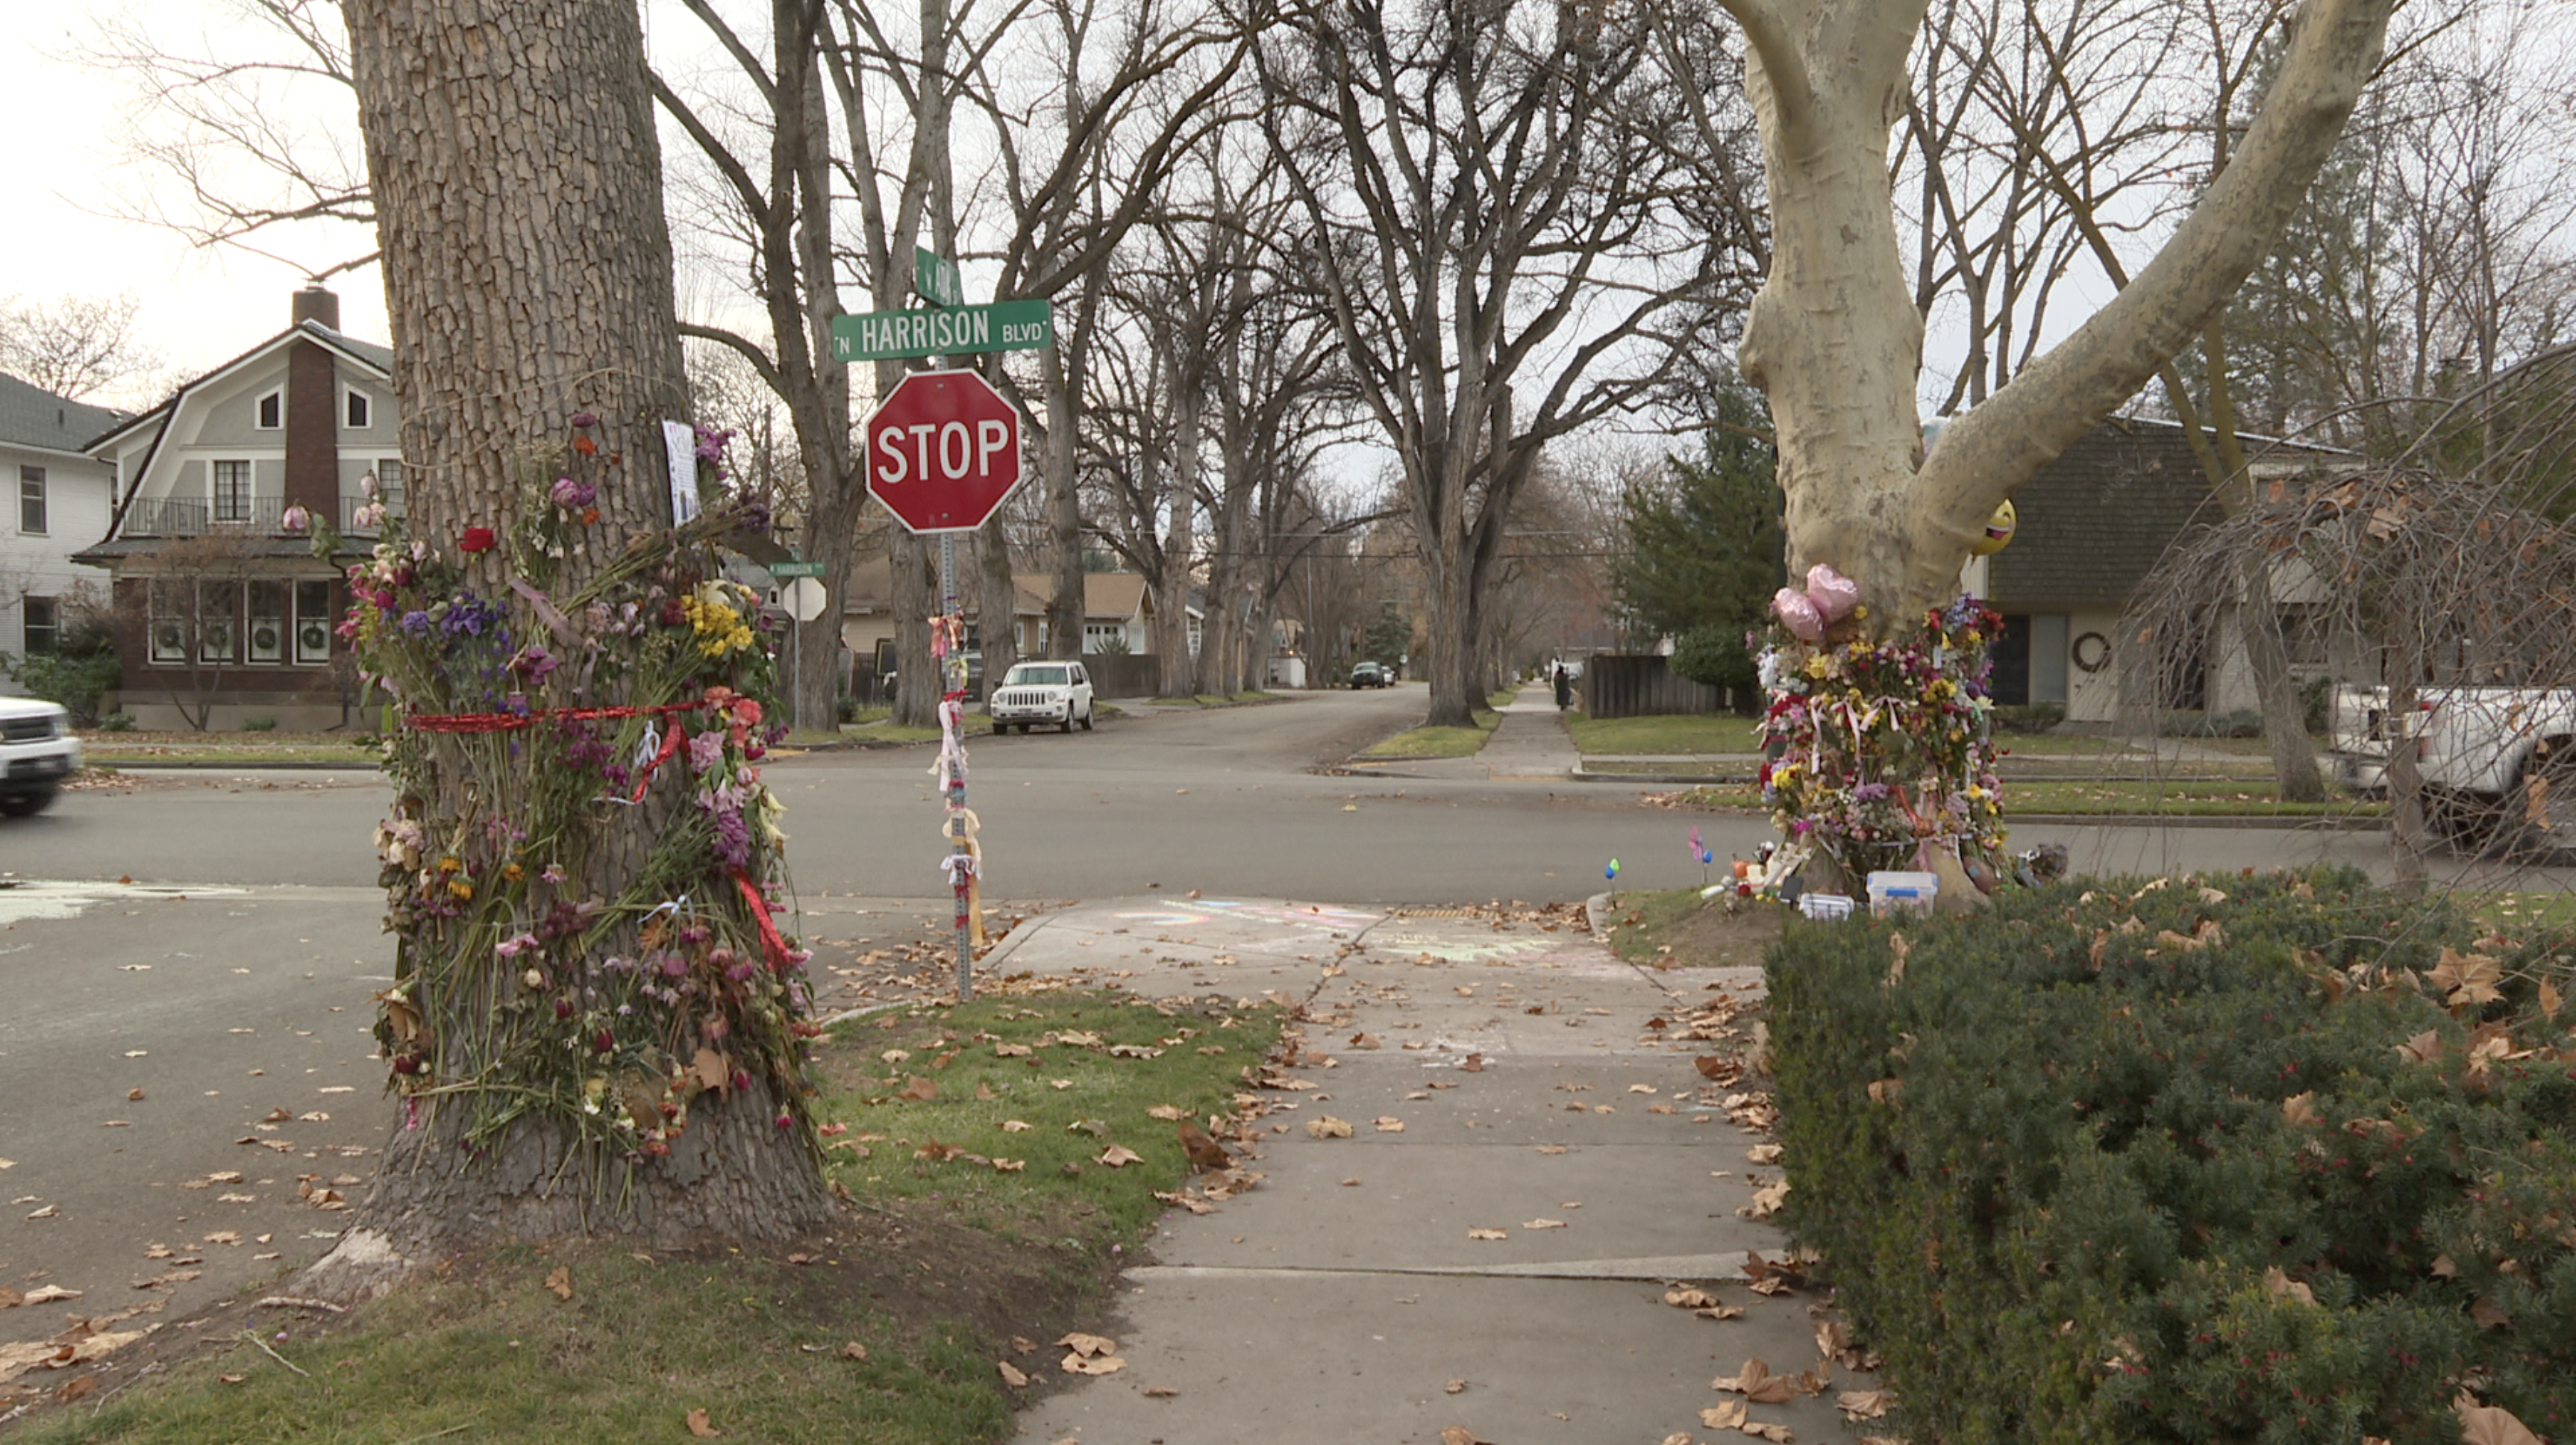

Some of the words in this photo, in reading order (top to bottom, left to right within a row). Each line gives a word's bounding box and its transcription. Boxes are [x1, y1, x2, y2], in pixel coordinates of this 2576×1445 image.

[839, 337, 850, 355] N
[862, 310, 989, 352] HARRISON
[1002, 323, 1042, 343] BLVD
[878, 419, 1009, 483] STOP
